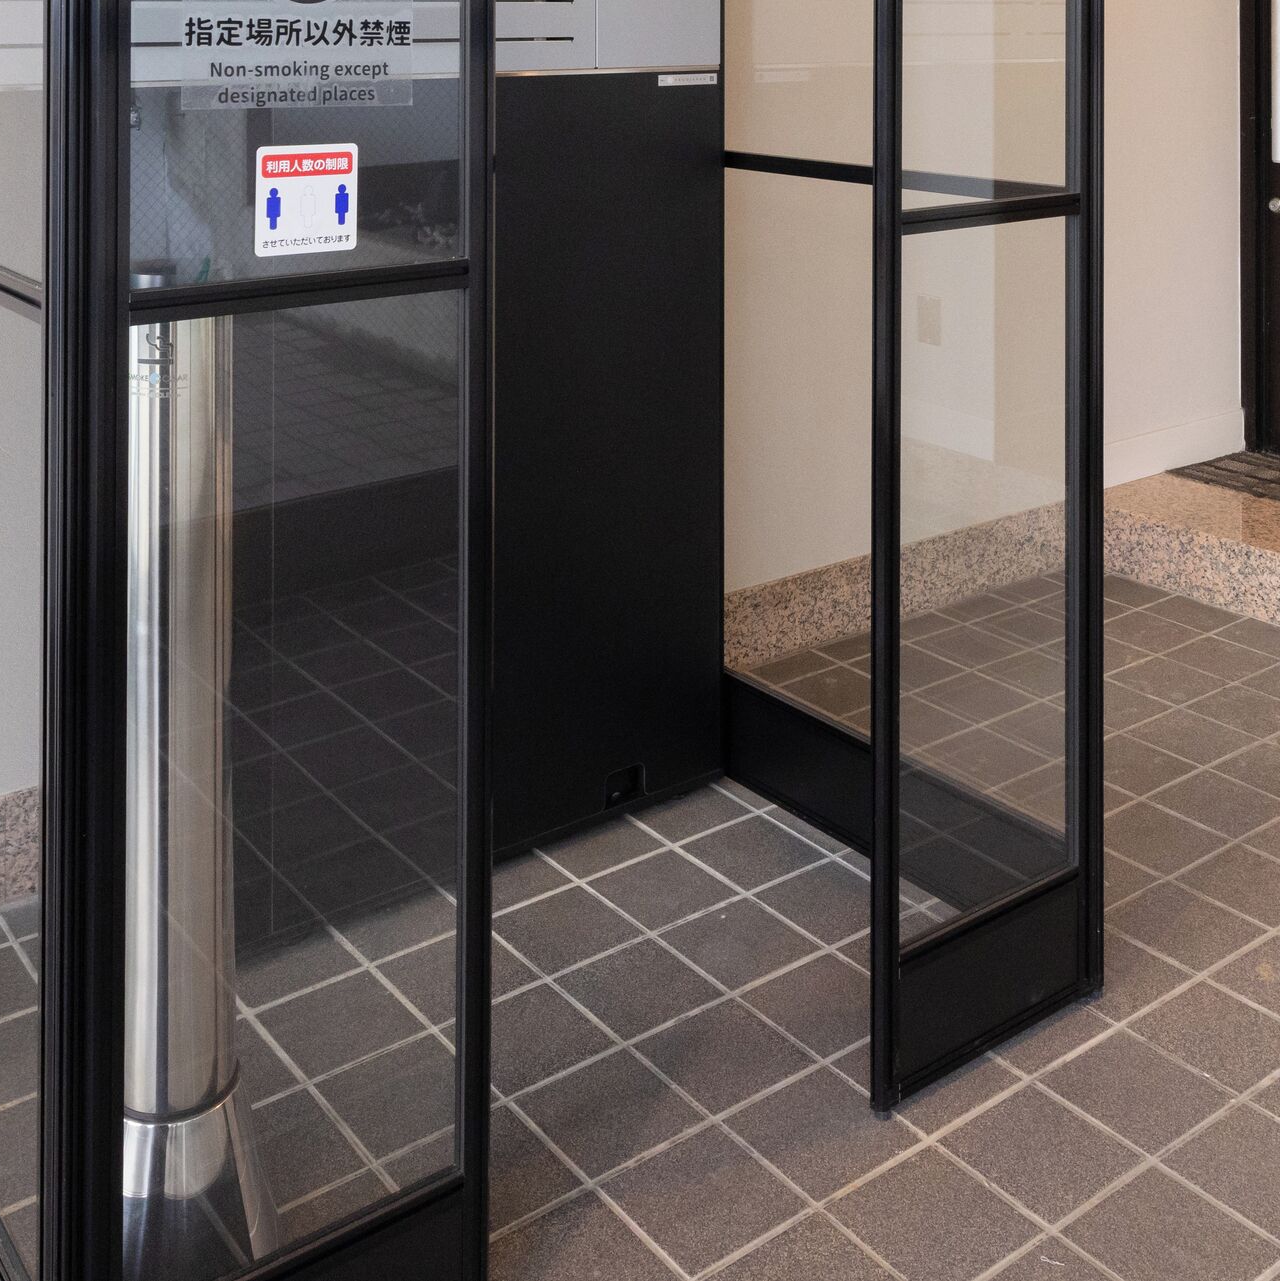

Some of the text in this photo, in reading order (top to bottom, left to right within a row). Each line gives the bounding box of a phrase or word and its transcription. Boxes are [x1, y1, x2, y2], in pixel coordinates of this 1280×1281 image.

[185, 17, 411, 47] 指定場所以外禁煙
[210, 61, 389, 80] Non-smoking except
[218, 87, 376, 106] designated places
[265, 157, 349, 174] 利用人数の制限
[262, 234, 351, 249] させていただいております
